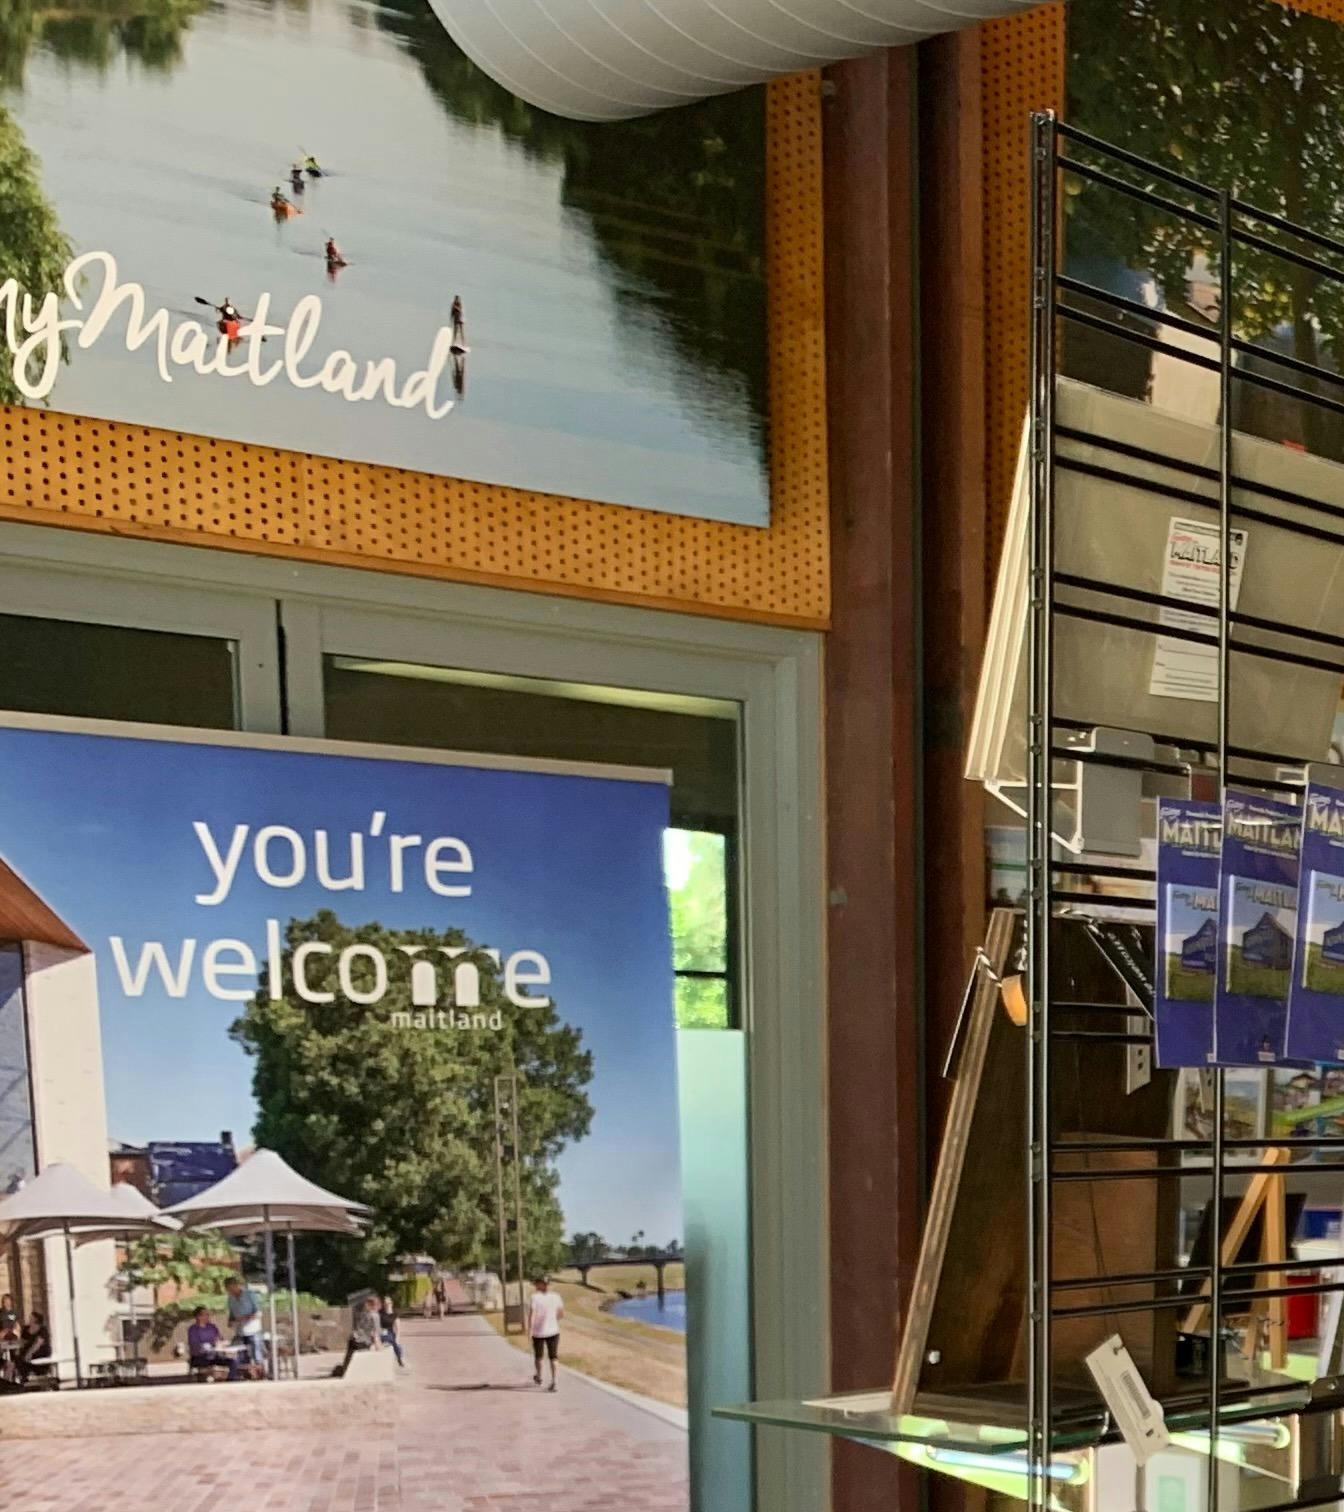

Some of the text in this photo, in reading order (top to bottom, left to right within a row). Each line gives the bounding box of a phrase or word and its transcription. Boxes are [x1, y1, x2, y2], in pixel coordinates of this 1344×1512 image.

[193, 810, 475, 907] you're
[110, 919, 552, 1010] welcome
[390, 1007, 504, 1033] maitland
